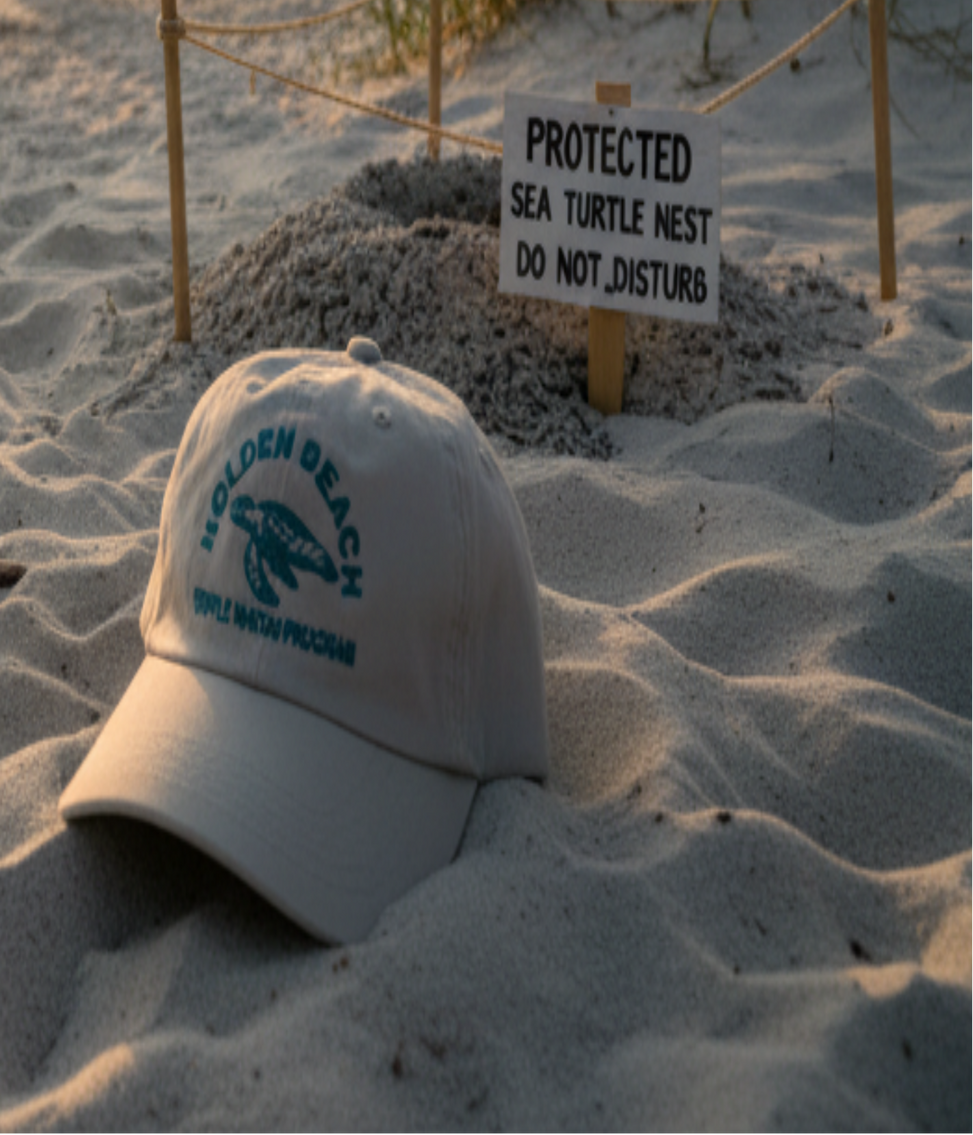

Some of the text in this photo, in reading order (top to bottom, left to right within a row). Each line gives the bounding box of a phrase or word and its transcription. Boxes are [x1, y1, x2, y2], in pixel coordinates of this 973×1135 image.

[526, 116, 693, 184] PROTECTED
[510, 181, 714, 245] SEA TURTLE NEST
[516, 239, 546, 281] DO
[556, 246, 602, 288] NOT
